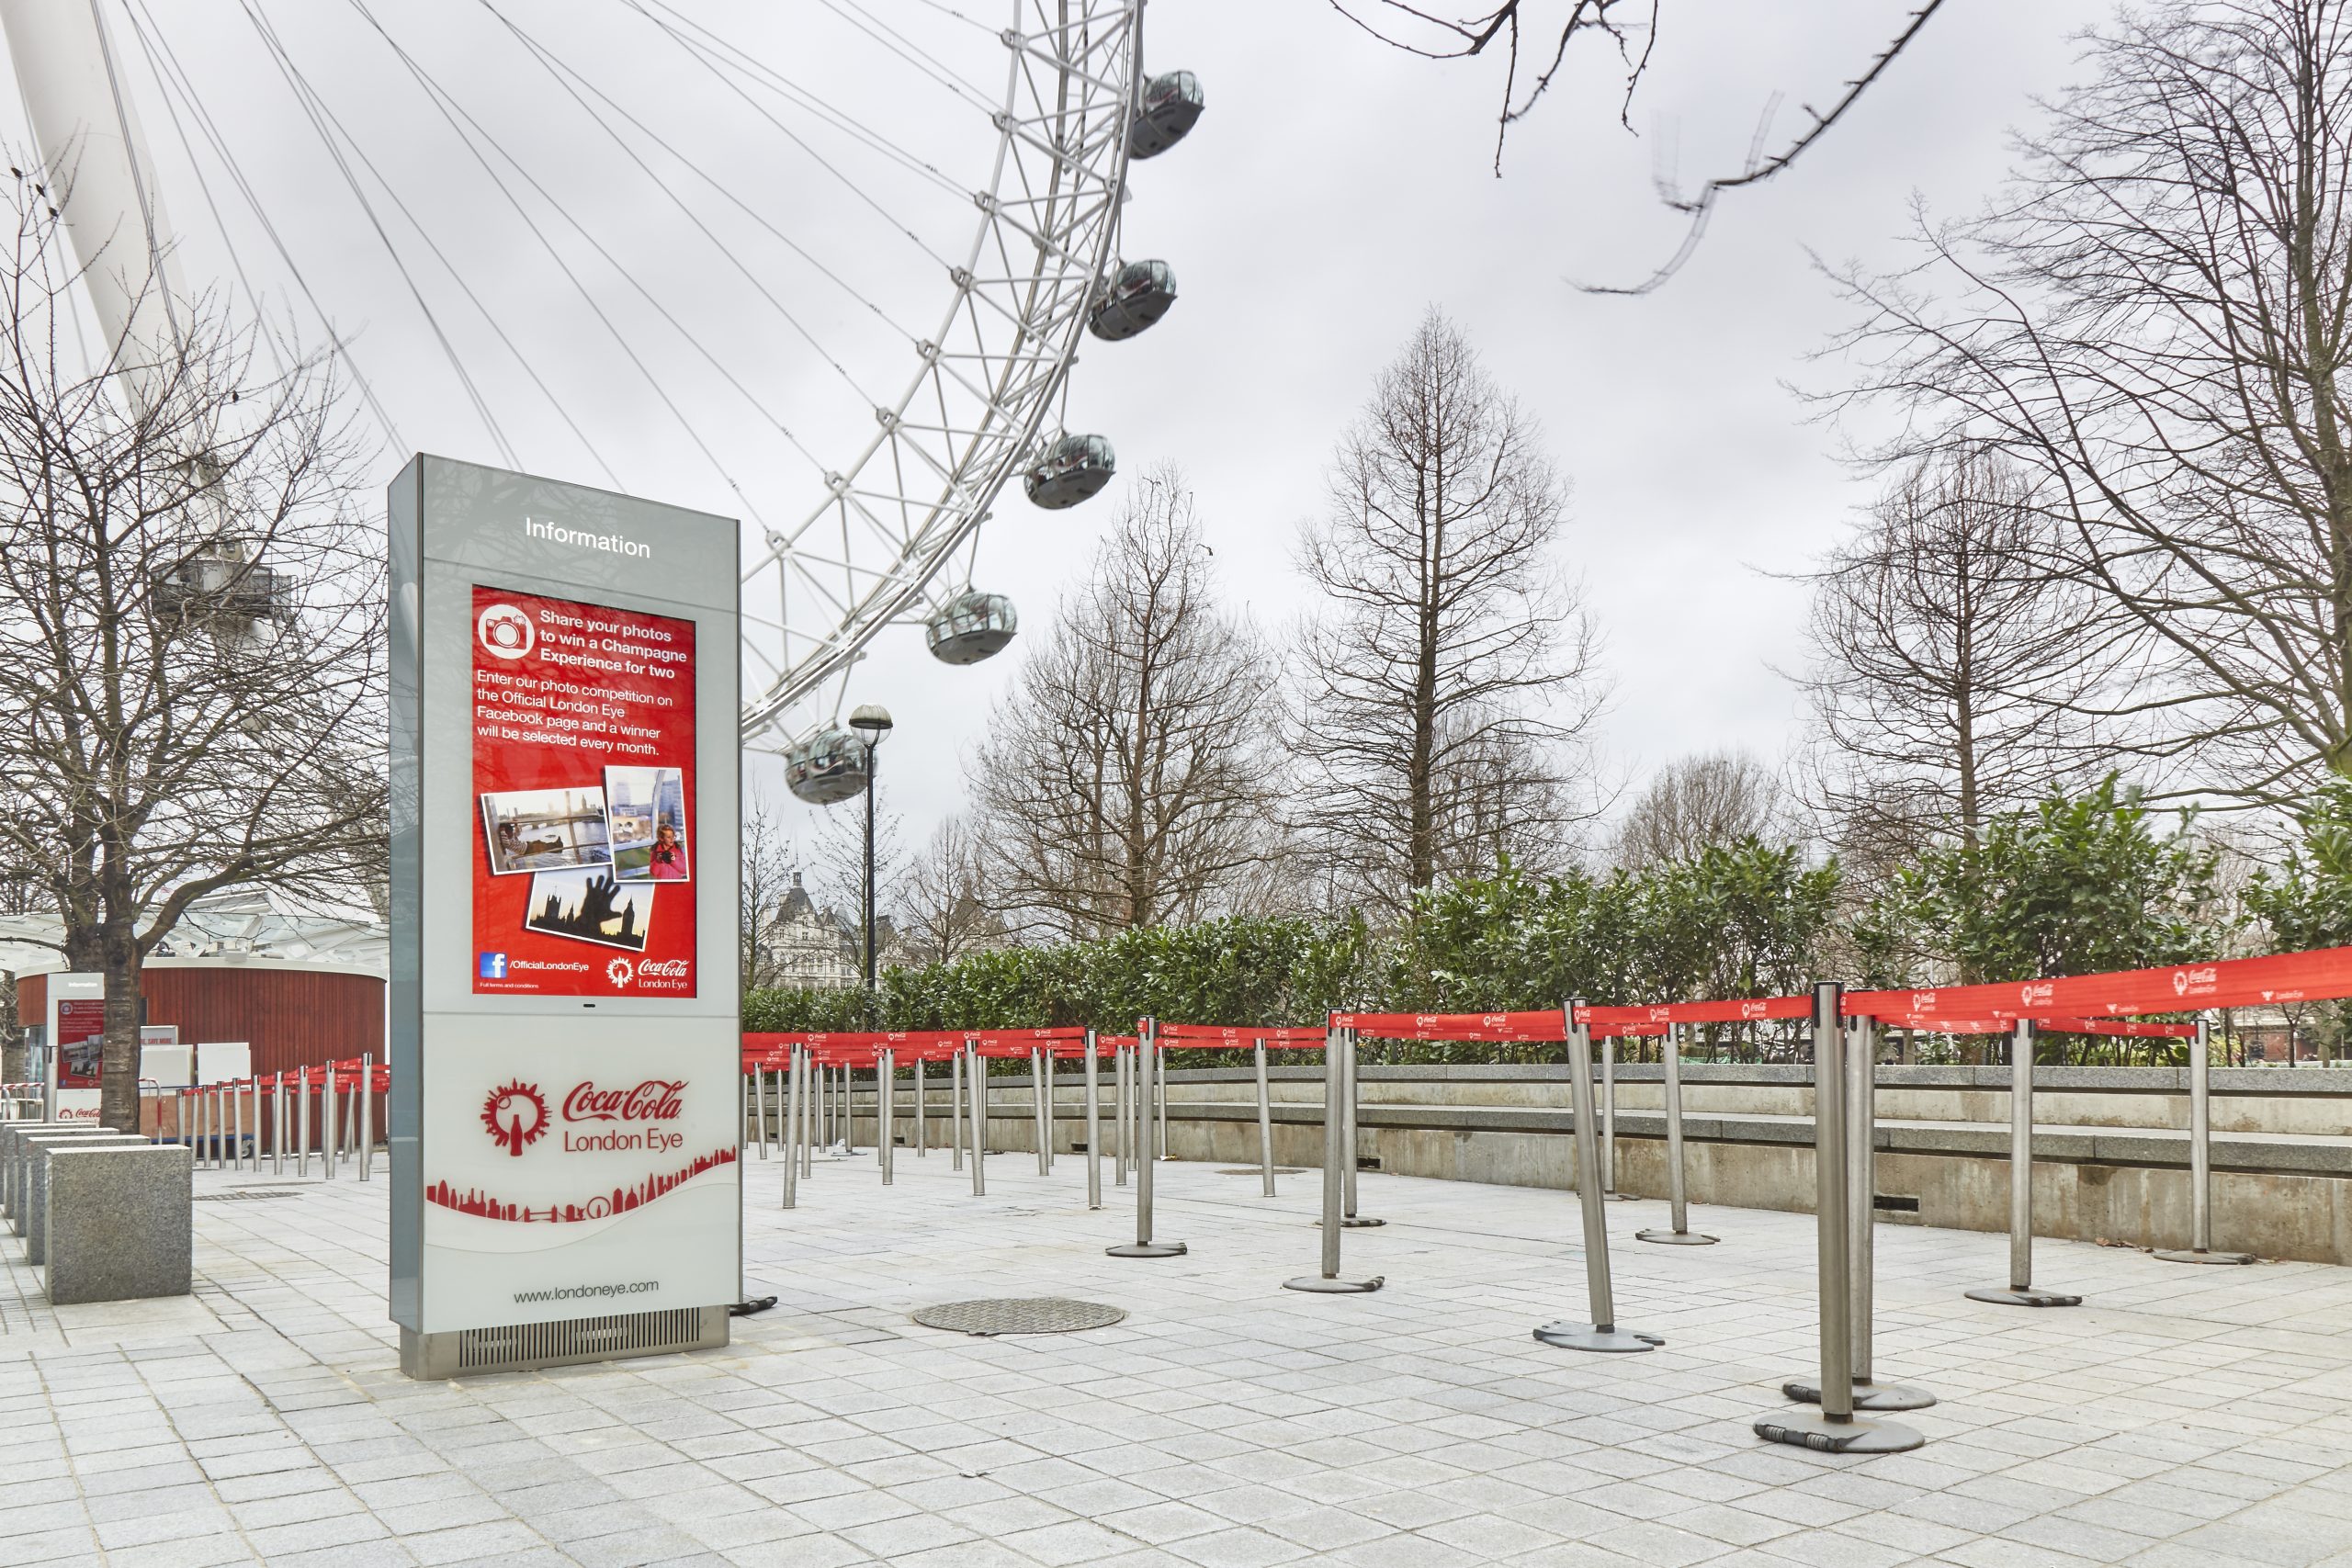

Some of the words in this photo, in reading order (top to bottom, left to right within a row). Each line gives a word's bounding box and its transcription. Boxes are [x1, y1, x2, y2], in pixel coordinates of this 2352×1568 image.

[526, 517, 650, 558] Information
[539, 609, 583, 628] Share
[586, 618, 621, 635] your
[622, 622, 672, 642] photos
[539, 629, 556, 643] to
[559, 633, 585, 648] win
[588, 639, 598, 649] a
[601, 638, 687, 663] Champagne
[539, 647, 623, 672] Experience
[626, 659, 646, 675] for
[649, 663, 676, 679] two
[477, 669, 513, 686] Enter
[515, 676, 538, 689] our
[540, 679, 579, 694] photo
[581, 686, 655, 705] competition
[657, 695, 673, 706] on
[477, 688, 499, 702] the
[502, 691, 547, 708] Official
[549, 696, 598, 714] London
[602, 704, 626, 717] Eye
[477, 705, 544, 725] Facebook
[547, 716, 580, 731] page
[582, 718, 606, 732] and
[609, 725, 617, 734] a
[620, 725, 661, 739] winner
[477, 726, 499, 738] will
[502, 727, 519, 739] be
[522, 729, 577, 747] selected
[580, 738, 614, 753] every
[616, 741, 660, 756] month.
[509, 960, 590, 973] /OfficialLondonEye
[638, 958, 690, 976] Coca-Cola
[639, 978, 671, 989] London
[672, 979, 688, 991] Eye
[561, 1078, 690, 1122] Coca-Cola
[563, 1130, 642, 1154] London
[646, 1128, 684, 1154] Eye
[514, 1280, 659, 1304] www.londoneye.com
